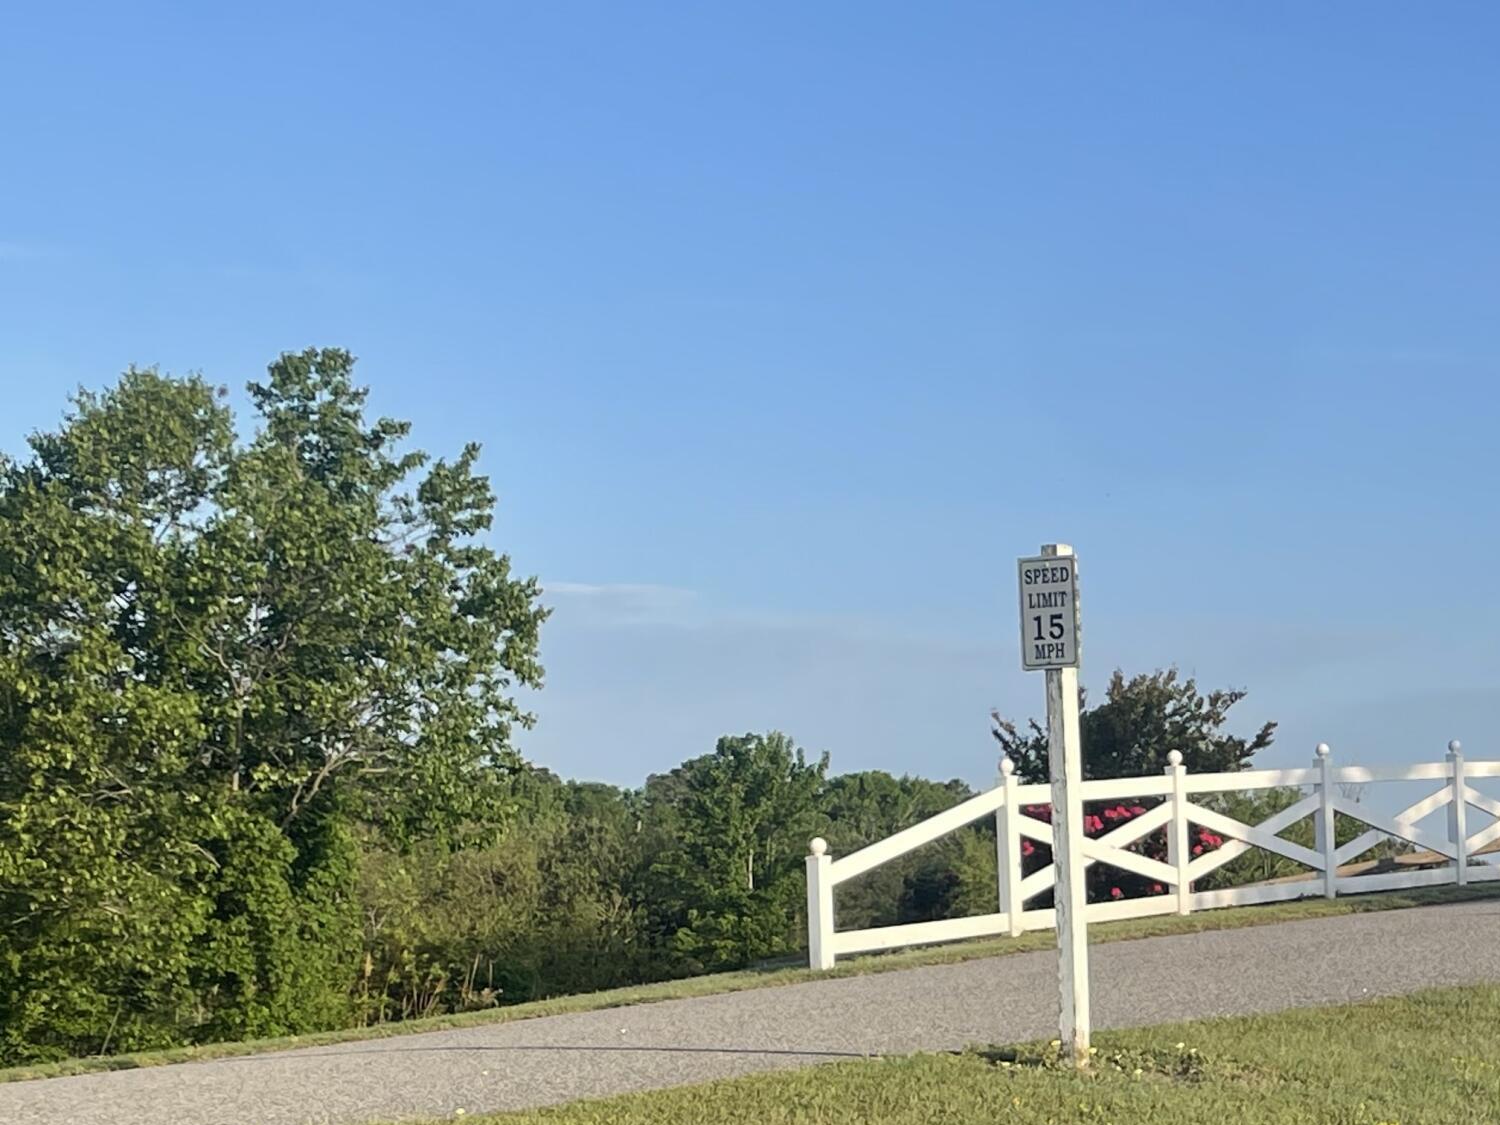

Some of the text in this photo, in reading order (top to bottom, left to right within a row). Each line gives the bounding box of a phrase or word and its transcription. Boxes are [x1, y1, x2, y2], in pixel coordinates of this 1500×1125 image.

[1024, 567, 1069, 585] SPEED
[1028, 591, 1067, 609] LIMIT
[1033, 613, 1064, 640] 15
[1034, 643, 1065, 660] MPH
